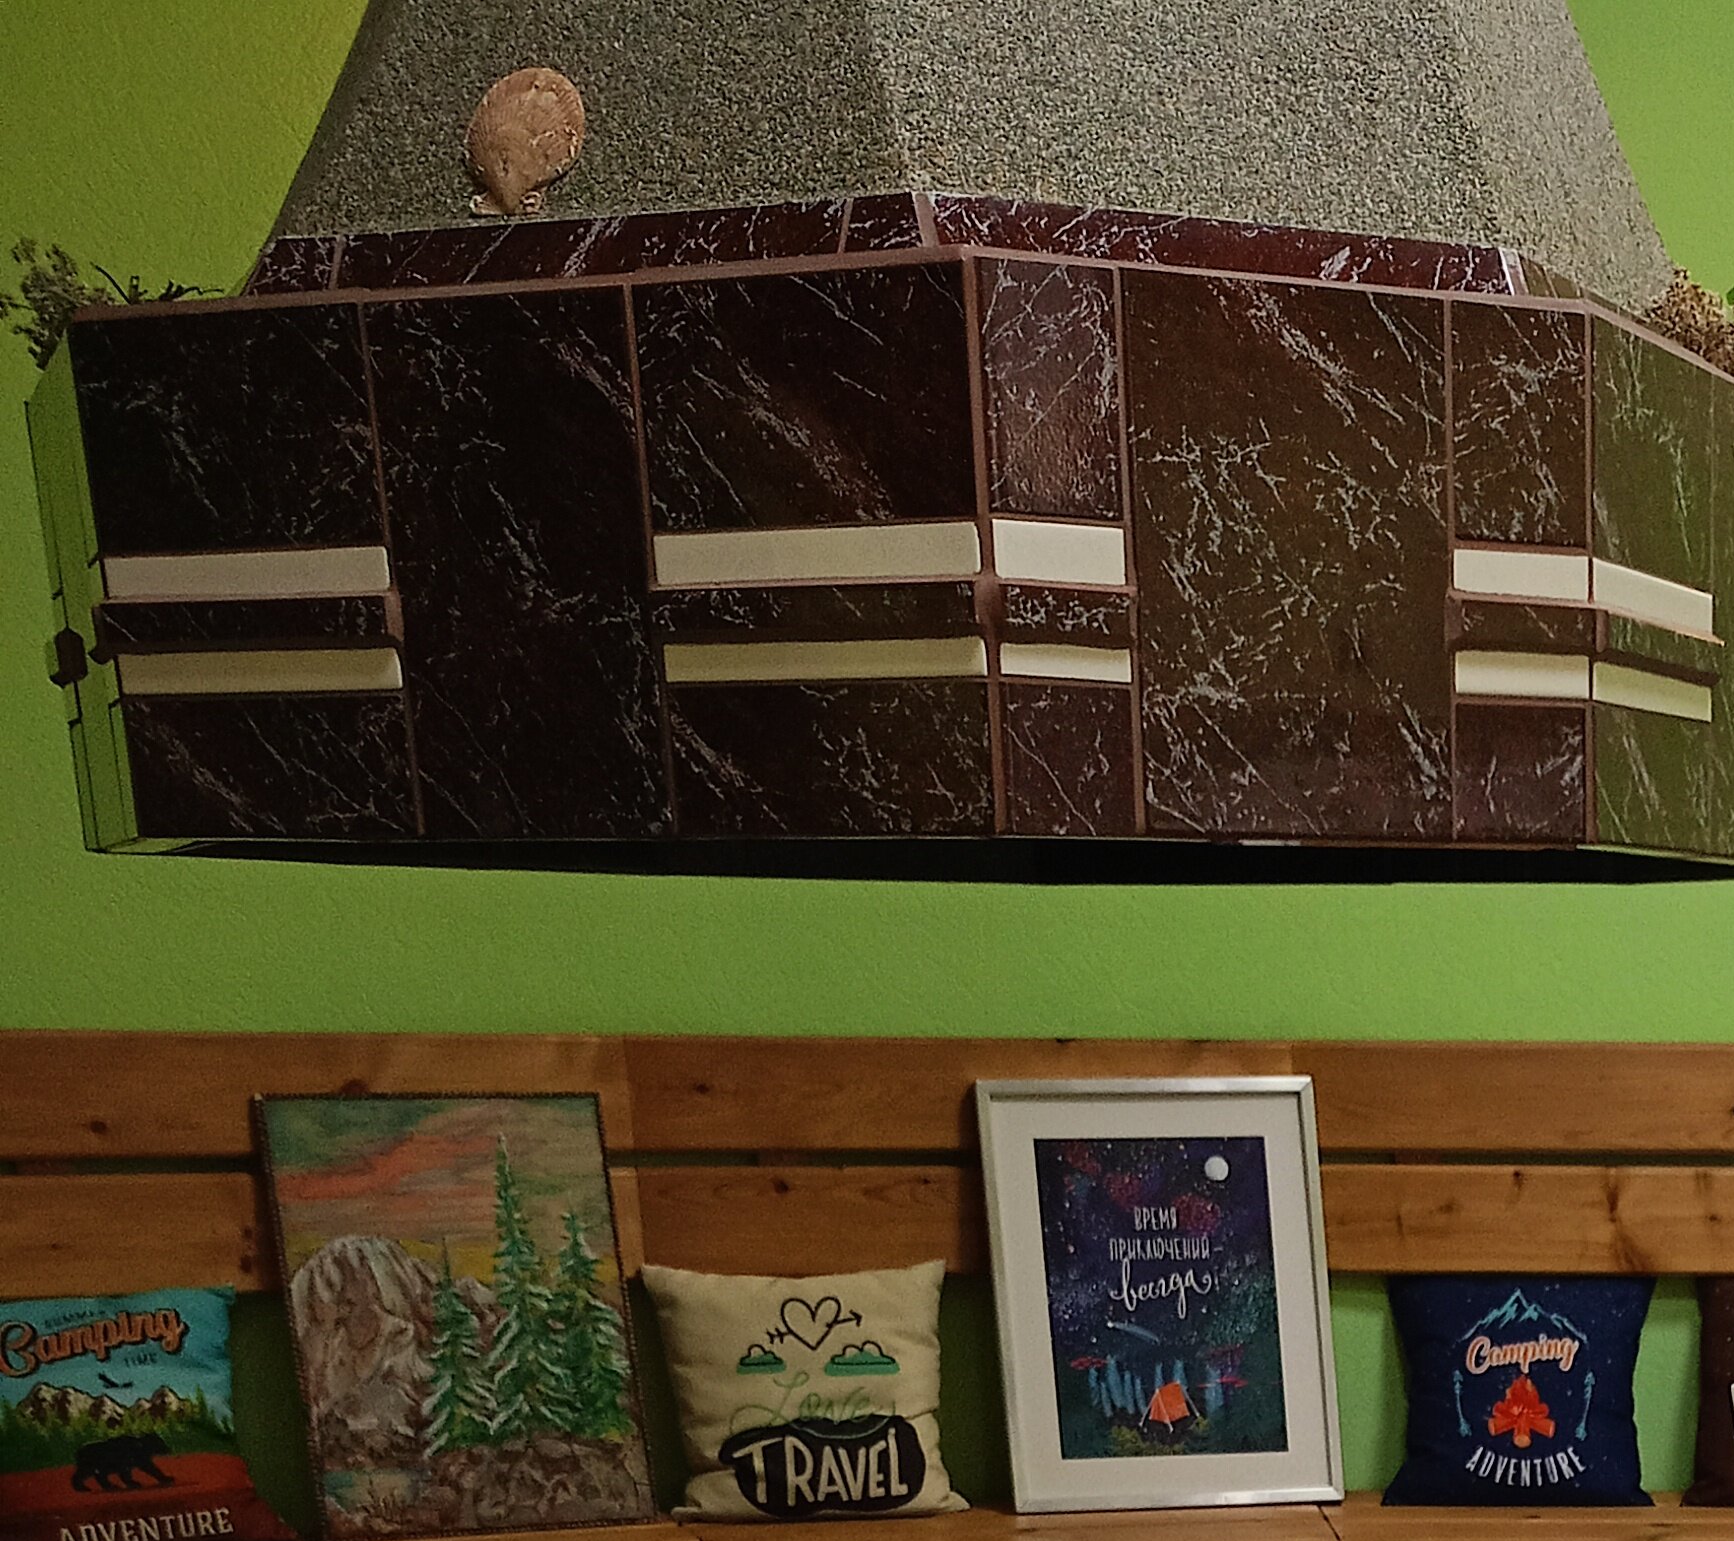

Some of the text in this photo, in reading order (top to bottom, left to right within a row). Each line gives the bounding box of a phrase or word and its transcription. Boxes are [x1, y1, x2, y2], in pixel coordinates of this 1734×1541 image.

[1134, 1206, 1177, 1231] ВРЕМЯ
[0, 1308, 189, 1378] Camping
[1466, 1333, 1580, 1375] Camping
[732, 1426, 909, 1507] TRAVEL
[1465, 1446, 1587, 1487] ADVENTURE
